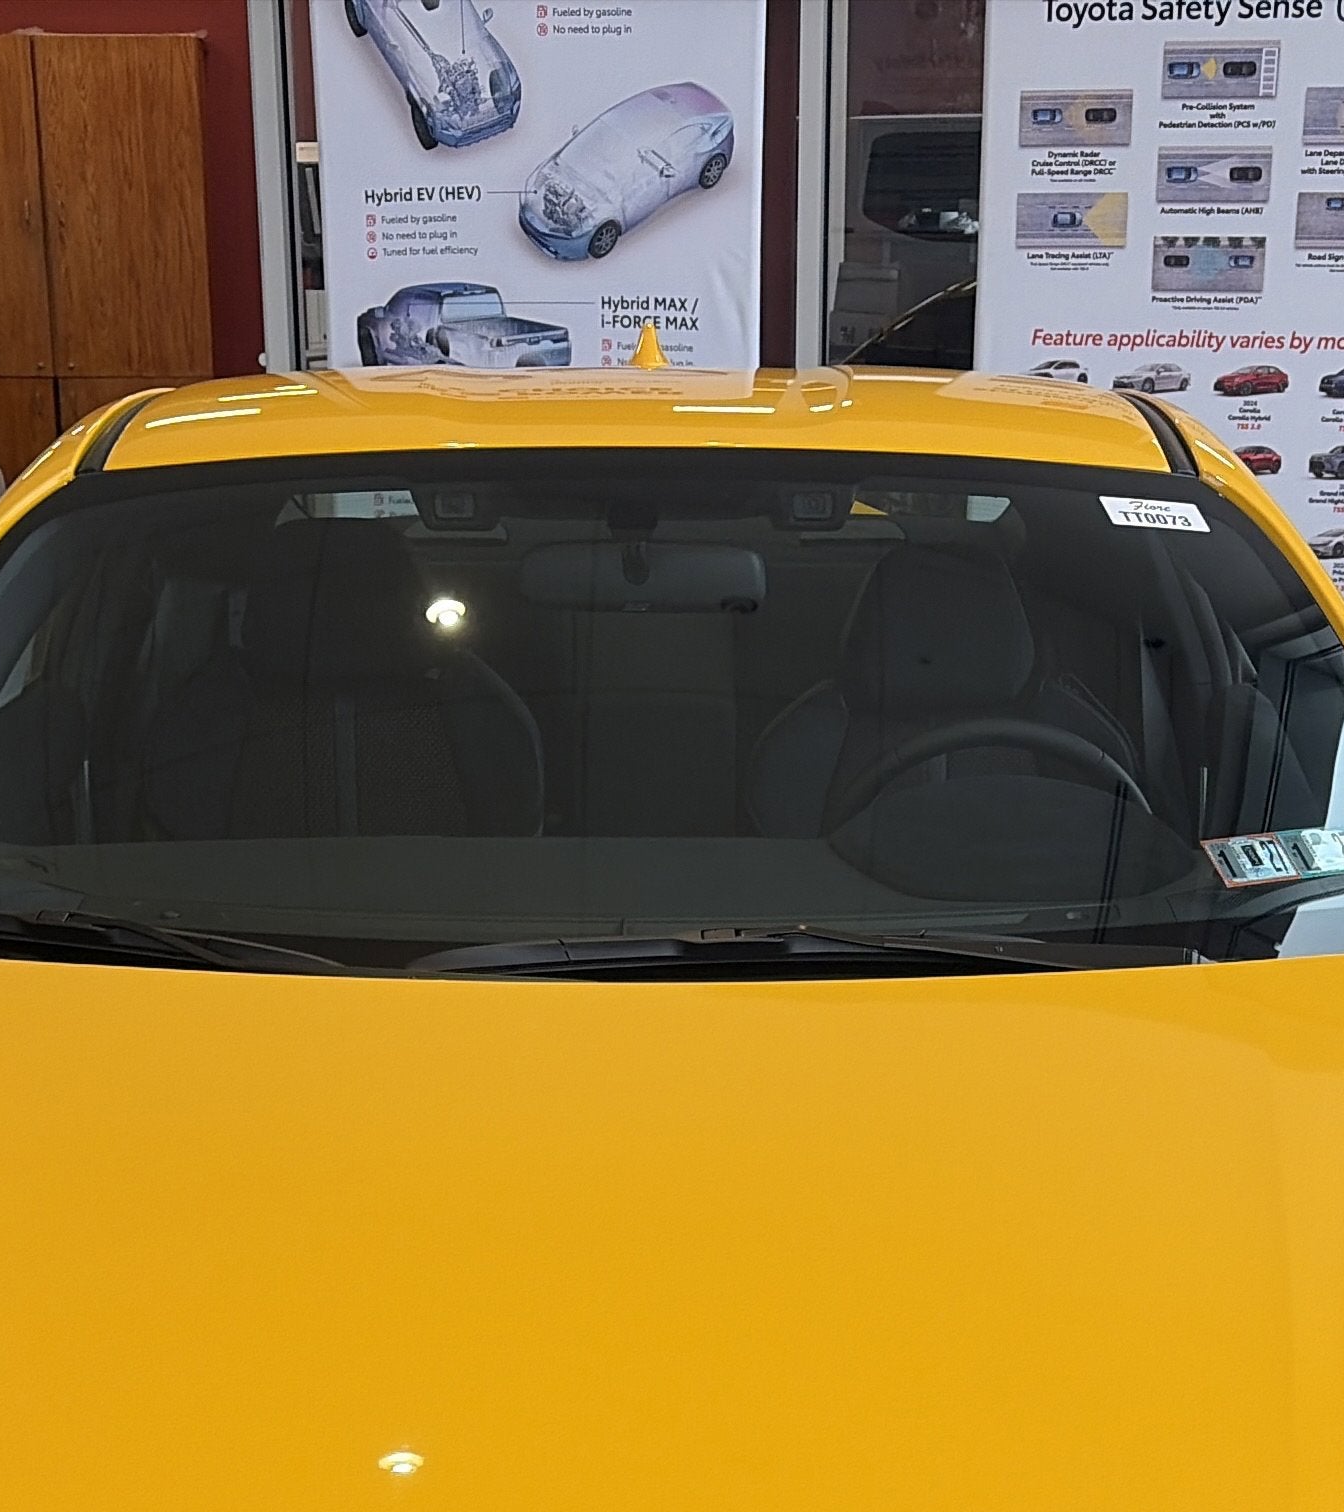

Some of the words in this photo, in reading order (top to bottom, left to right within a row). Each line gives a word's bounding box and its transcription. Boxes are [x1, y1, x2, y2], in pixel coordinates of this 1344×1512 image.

[552, 7, 582, 17] Fueled
[583, 7, 594, 18] by
[595, 7, 632, 18] gasoline
[1044, 0, 1133, 28] Toyota
[1141, 0, 1231, 26] Safety
[1237, 0, 1323, 19] Sense
[552, 25, 565, 34] No
[567, 25, 589, 34] need
[591, 25, 601, 34] to
[602, 24, 622, 35] plug
[623, 25, 632, 33] in
[1229, 103, 1255, 111] System
[1321, 158, 1338, 166] Lane
[1070, 169, 1092, 177] Range
[364, 187, 413, 206] Hybrid
[417, 187, 435, 201] EV
[439, 185, 481, 202] (HEV)
[381, 215, 408, 224] Fueled
[410, 215, 420, 225] by
[422, 214, 457, 225] gasoline
[382, 232, 394, 240] No
[396, 231, 416, 240] need
[418, 231, 427, 239] to
[429, 230, 448, 240] plug
[450, 230, 457, 238] in
[383, 247, 407, 257] Tuned
[409, 246, 420, 256] for
[422, 246, 438, 255] fuel
[439, 245, 478, 256] efficiency
[1027, 252, 1044, 260] Lane
[1328, 253, 1344, 262] Sign
[601, 295, 650, 313] Hybrid
[654, 297, 688, 312] MAX
[690, 298, 699, 315] /
[665, 316, 699, 331] MAX
[1031, 328, 1103, 347] Feature
[1106, 330, 1226, 352] applicability
[1230, 332, 1285, 349] varies
[1289, 331, 1313, 354] by
[1119, 511, 1192, 527] TT0073
